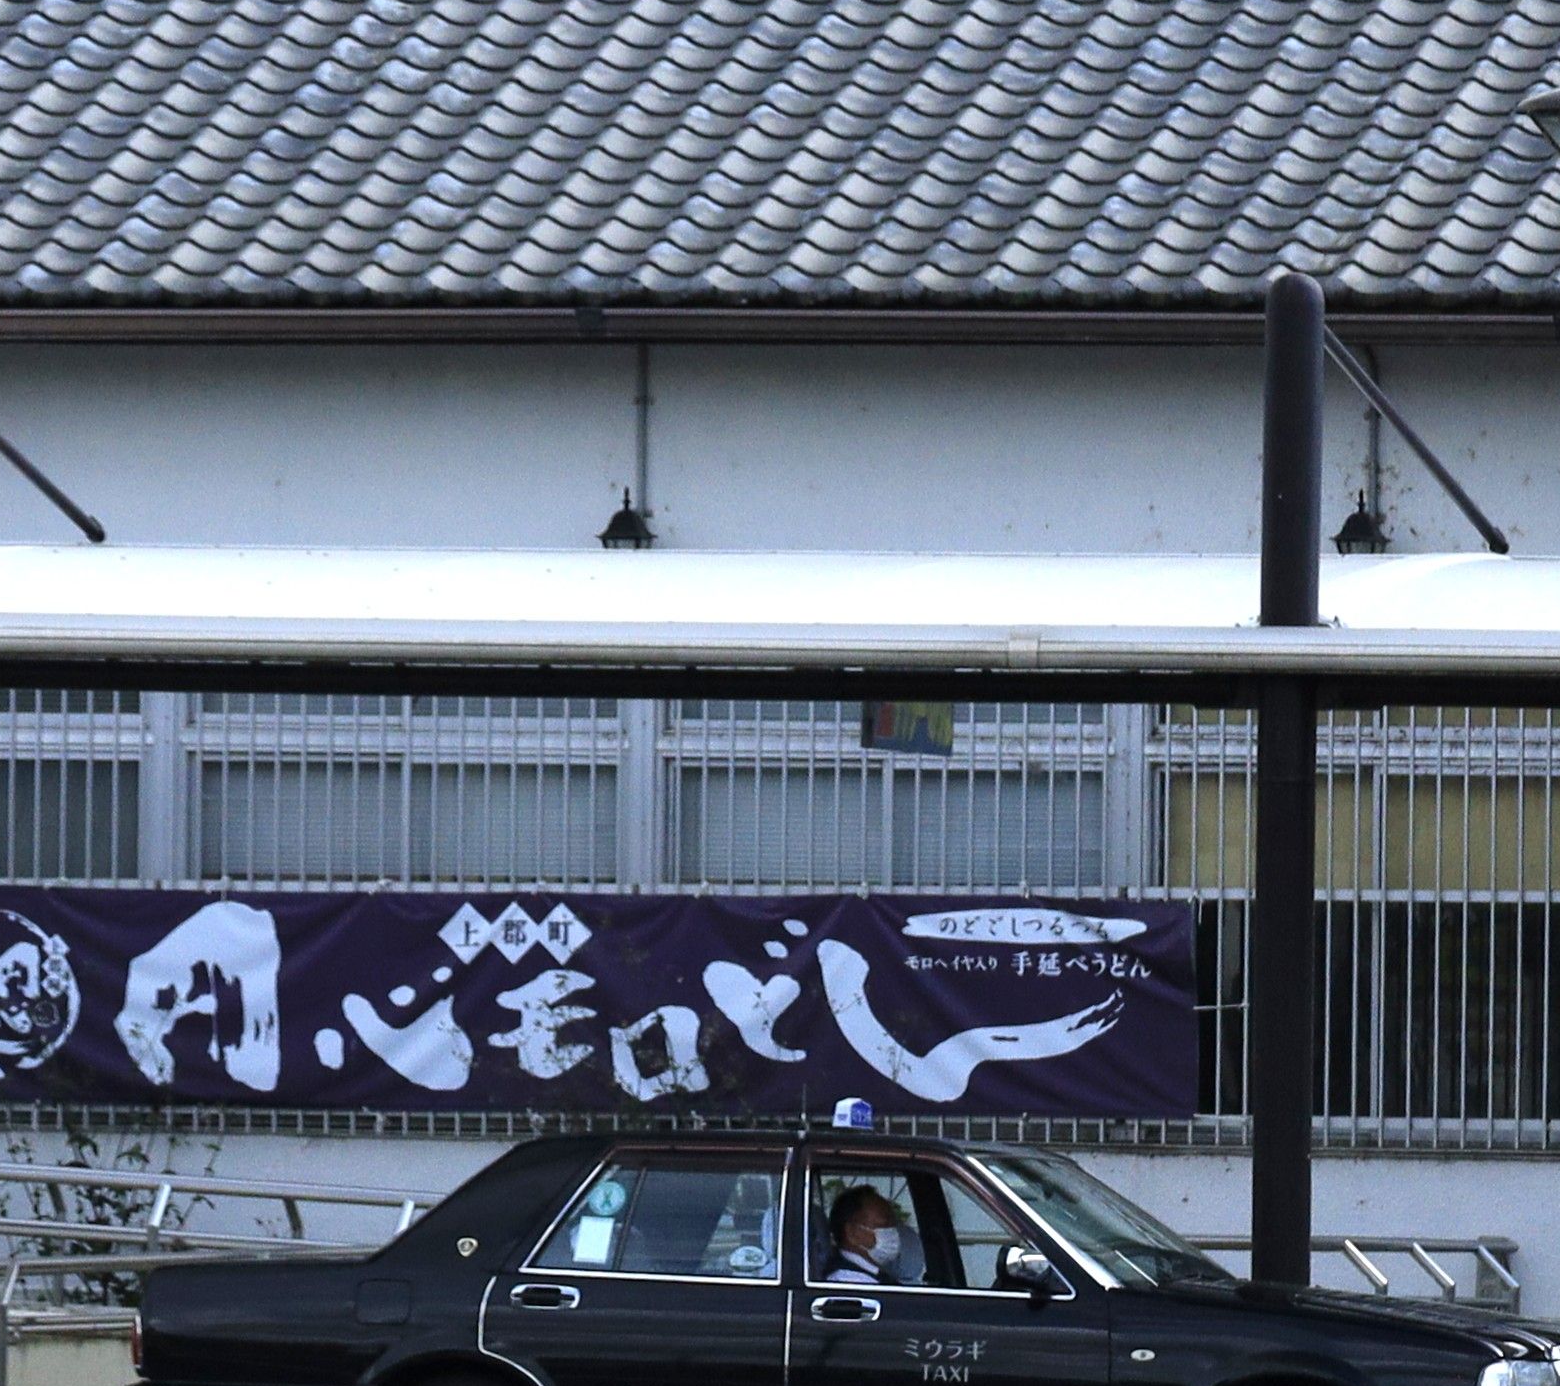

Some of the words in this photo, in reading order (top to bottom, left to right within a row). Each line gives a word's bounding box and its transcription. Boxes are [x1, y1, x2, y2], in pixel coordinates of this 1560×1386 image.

[455, 913, 573, 947] 上郡町
[939, 915, 1109, 940] のどごしつるつる
[905, 954, 998, 972] モロヘイヤ入り
[1010, 951, 1152, 978] 手延べうどん
[904, 1338, 987, 1361] ミウラギ
[920, 1364, 970, 1382] TAXI
